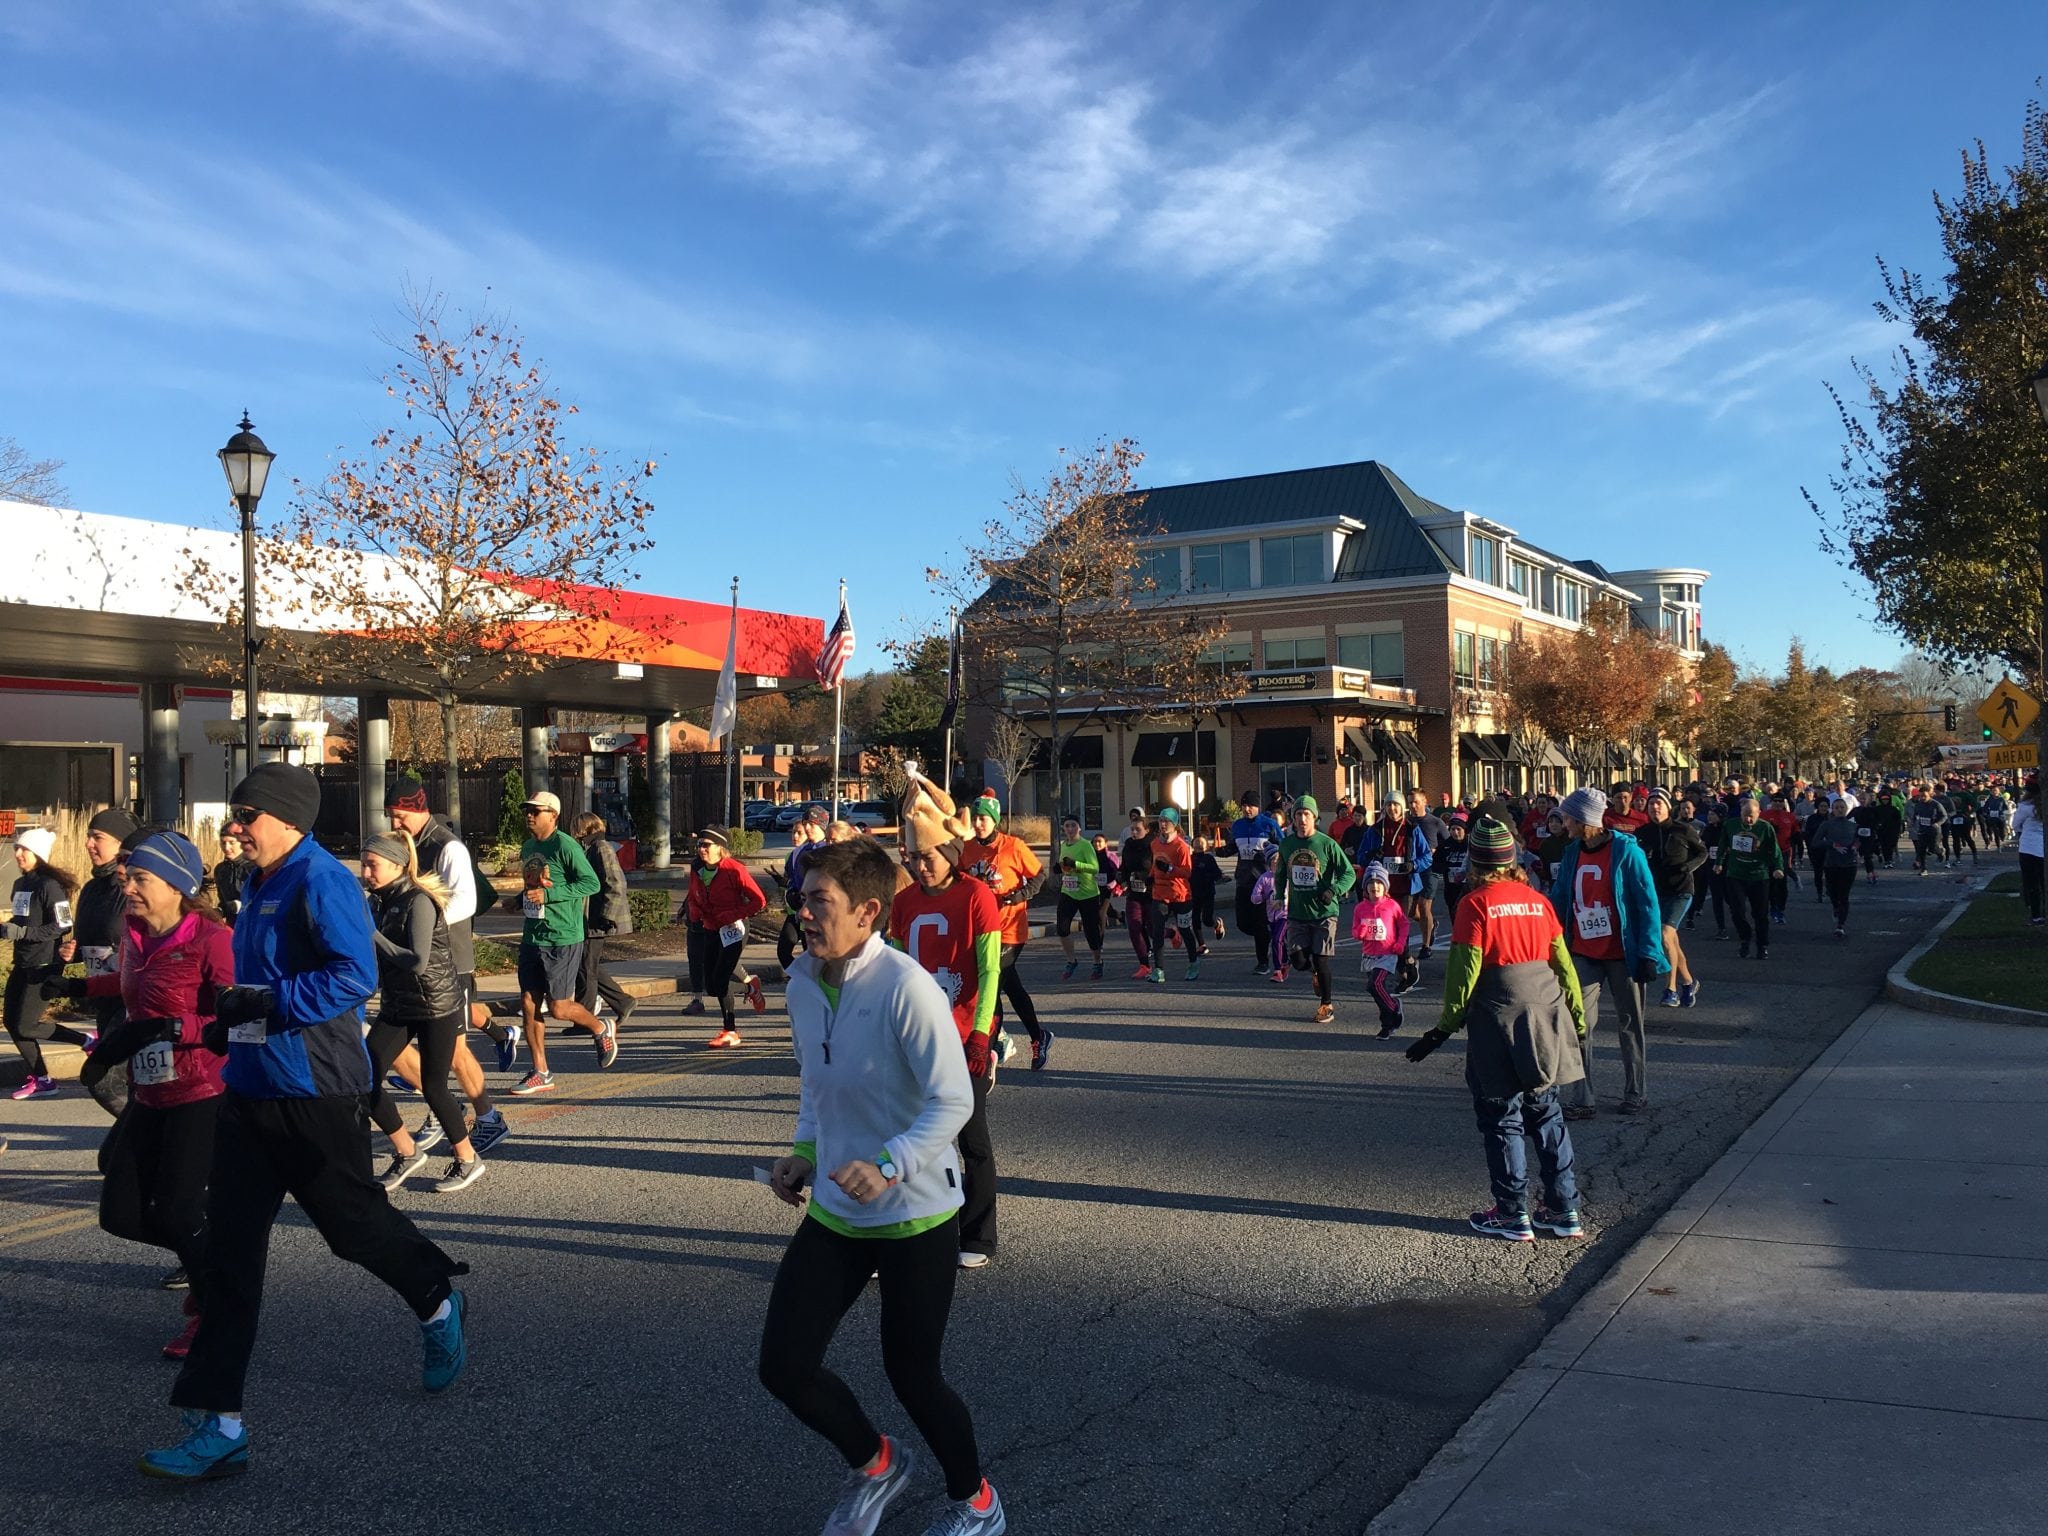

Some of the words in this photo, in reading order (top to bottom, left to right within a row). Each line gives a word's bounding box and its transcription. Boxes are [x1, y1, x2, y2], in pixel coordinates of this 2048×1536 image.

[1258, 675, 1305, 686] ROOSTERS
[595, 737, 617, 746] CITGO
[1995, 750, 2032, 765] AHEAD
[1294, 871, 1315, 880] 1082
[1575, 864, 1602, 911] C
[1488, 903, 1543, 918] CONNOLLY
[1581, 917, 1608, 931] 1945
[134, 1050, 168, 1070] 1161
